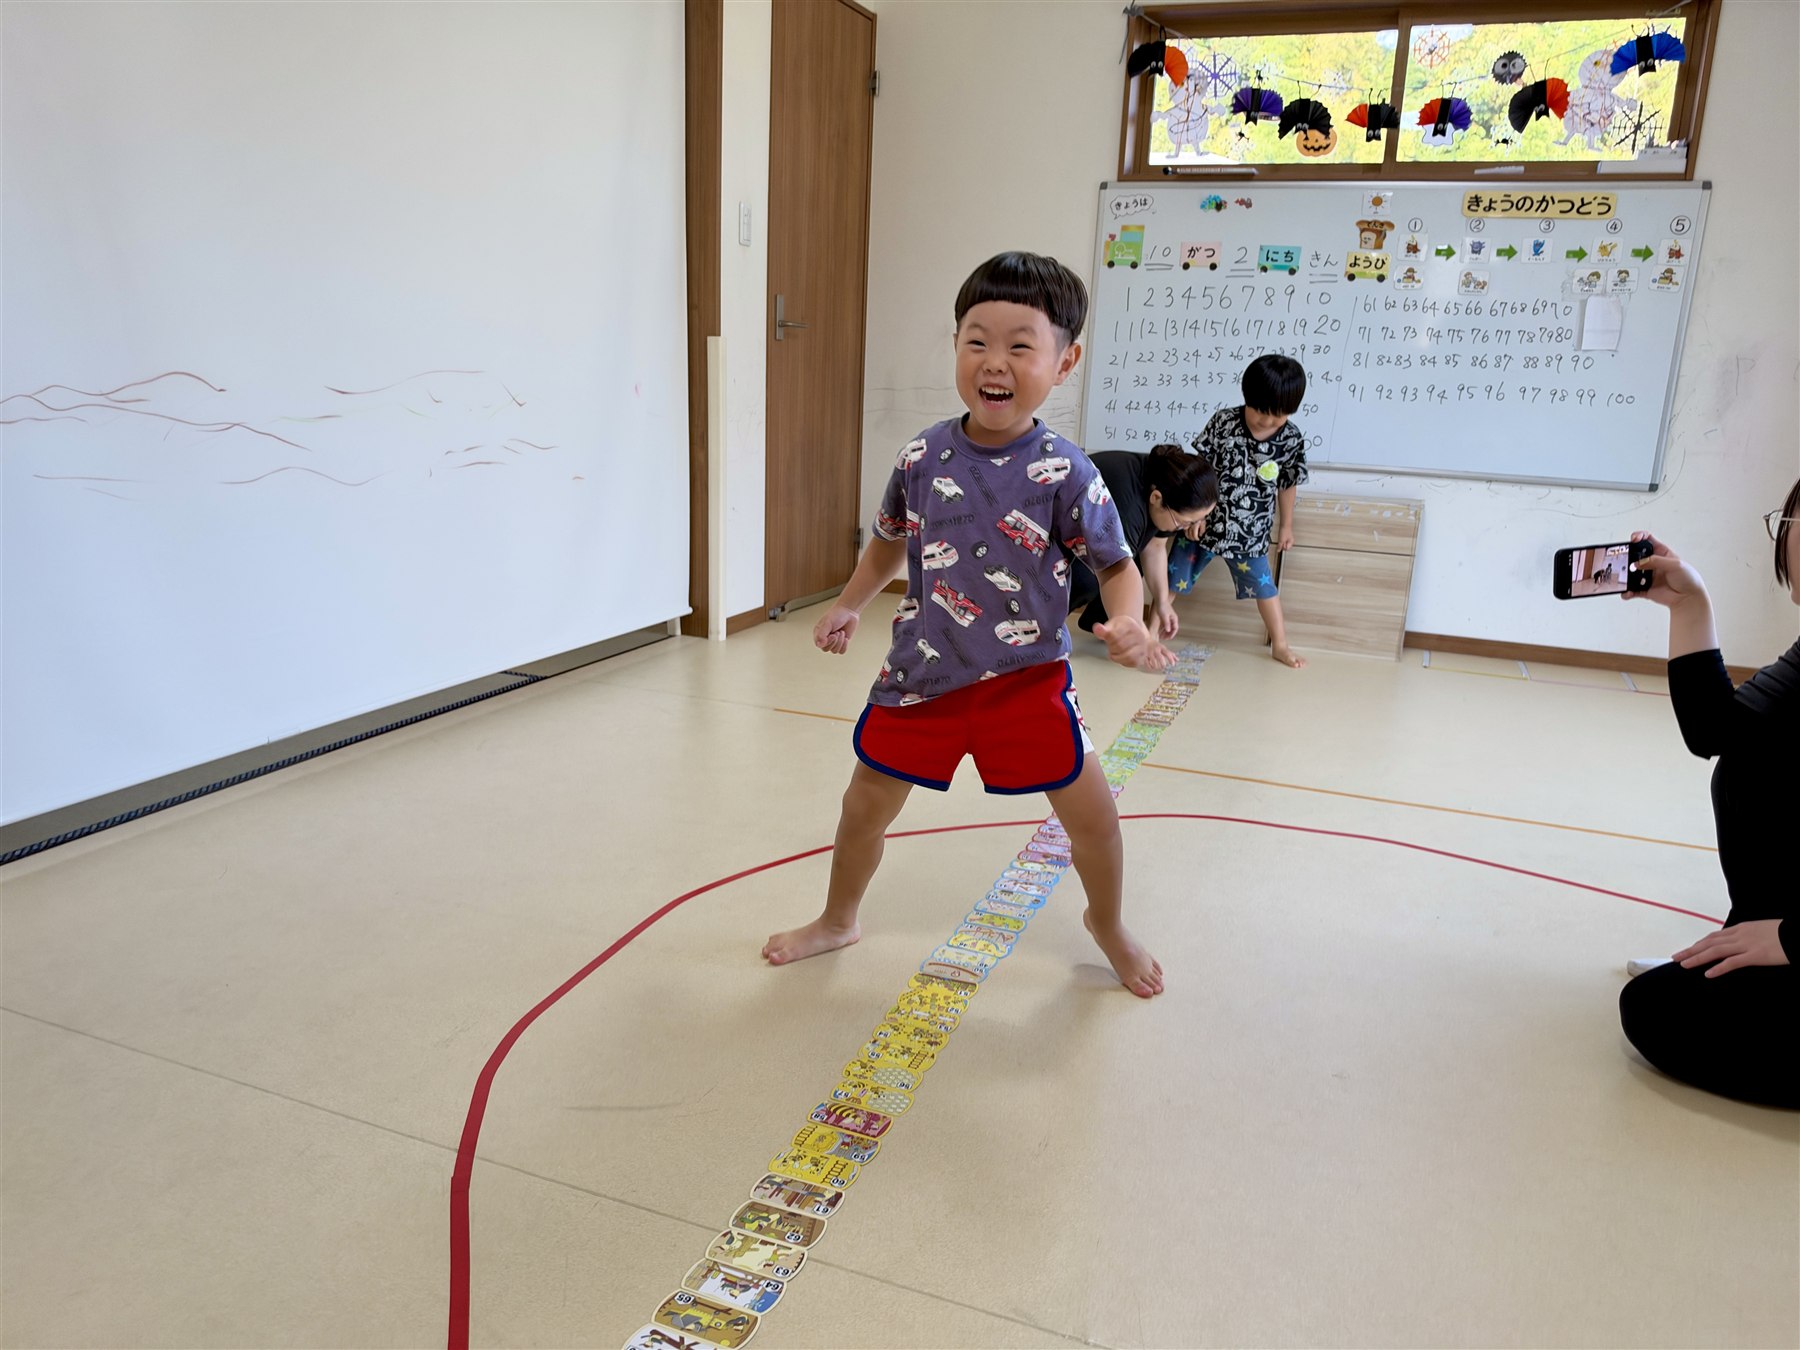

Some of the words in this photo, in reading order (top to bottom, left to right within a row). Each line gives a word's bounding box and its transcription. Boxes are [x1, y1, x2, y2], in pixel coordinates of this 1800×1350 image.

[1114, 198, 1148, 210] きょうは
[1467, 194, 1612, 215] きょうのかつどう
[1149, 246, 1171, 258] 10
[1187, 246, 1216, 258] がつ
[1233, 247, 1248, 264] 2
[1264, 250, 1294, 262] にち
[1310, 250, 1338, 268] きん
[1349, 255, 1387, 269] ようび
[1143, 287, 1154, 307] 2
[1165, 287, 1174, 308] 3
[1181, 286, 1196, 310] 4
[1202, 286, 1216, 310] 5
[1219, 284, 1232, 309] 6
[1242, 285, 1255, 312] 7
[1264, 287, 1275, 306] 8
[1284, 284, 1295, 313] 9
[1307, 292, 1331, 305] 10
[1364, 295, 1376, 313] 61
[1385, 296, 1397, 311] 62
[1403, 298, 1418, 312] 63
[1422, 297, 1439, 317] 64
[1444, 301, 1462, 315] 65
[1465, 300, 1482, 316] 66
[1490, 300, 1508, 317] 67
[1510, 301, 1527, 314] 68
[1532, 298, 1547, 316] 69
[1551, 302, 1572, 320] 70
[1115, 321, 1133, 342] 11
[1140, 318, 1157, 337] 12
[1165, 318, 1178, 341] 13
[1183, 319, 1200, 339] 14
[1204, 318, 1224, 337] 15
[1222, 318, 1240, 337] 16
[1246, 319, 1263, 339] 17
[1268, 320, 1285, 336] 18
[1293, 318, 1307, 336] 19
[1313, 314, 1341, 335] 20
[1358, 326, 1371, 344] 71
[1381, 326, 1396, 341] 72
[1403, 326, 1417, 341] 73
[1427, 327, 1443, 345] 74
[1447, 329, 1465, 343] 75
[1471, 328, 1489, 343] 76
[1495, 329, 1511, 345] 77
[1518, 330, 1536, 344] 78
[1539, 327, 1554, 343] 79
[1555, 327, 1573, 342] 80
[1109, 351, 1128, 369] 21
[1136, 351, 1154, 363] 22
[1163, 348, 1178, 367] 23
[1183, 349, 1201, 368] 24
[1208, 347, 1224, 362] 25
[1229, 345, 1243, 361] 26
[1289, 344, 1306, 364] 29
[1313, 344, 1331, 354] 30
[1353, 352, 1369, 368] 81
[1376, 354, 1392, 366] 82
[1394, 355, 1412, 369] 83
[1420, 354, 1437, 368] 84
[1445, 354, 1461, 368] 85
[1471, 355, 1488, 369] 86
[1494, 354, 1514, 372] 87
[1523, 356, 1539, 369] 88
[1545, 354, 1563, 374] 89
[1571, 355, 1594, 372] 90
[1103, 377, 1119, 393] 31
[1133, 375, 1148, 388] 32
[1157, 373, 1172, 387] 33
[1181, 374, 1200, 388] 34
[1208, 372, 1225, 384] 35
[1321, 371, 1342, 384] 40
[1348, 384, 1364, 402] 91
[1376, 384, 1392, 400] 92
[1401, 385, 1418, 402] 93
[1427, 384, 1448, 405] 94
[1457, 383, 1476, 401] 95
[1485, 381, 1505, 401] 96
[1519, 386, 1541, 403] 97
[1550, 389, 1568, 403] 98
[1576, 389, 1596, 407] 99
[1607, 393, 1635, 407] 100
[1105, 399, 1117, 413] 41
[1125, 400, 1140, 414] 42
[1144, 400, 1161, 414] 43
[1167, 400, 1188, 418] 44
[1303, 403, 1319, 416] 50
[1105, 425, 1116, 440] 51
[1126, 429, 1137, 441] 52
[1164, 430, 1178, 442] 54
[815, 1206, 830, 1214] 61
[786, 1233, 801, 1241] 62
[775, 1267, 790, 1275] 63
[765, 1282, 780, 1290] 64
[677, 1294, 692, 1303] 65
